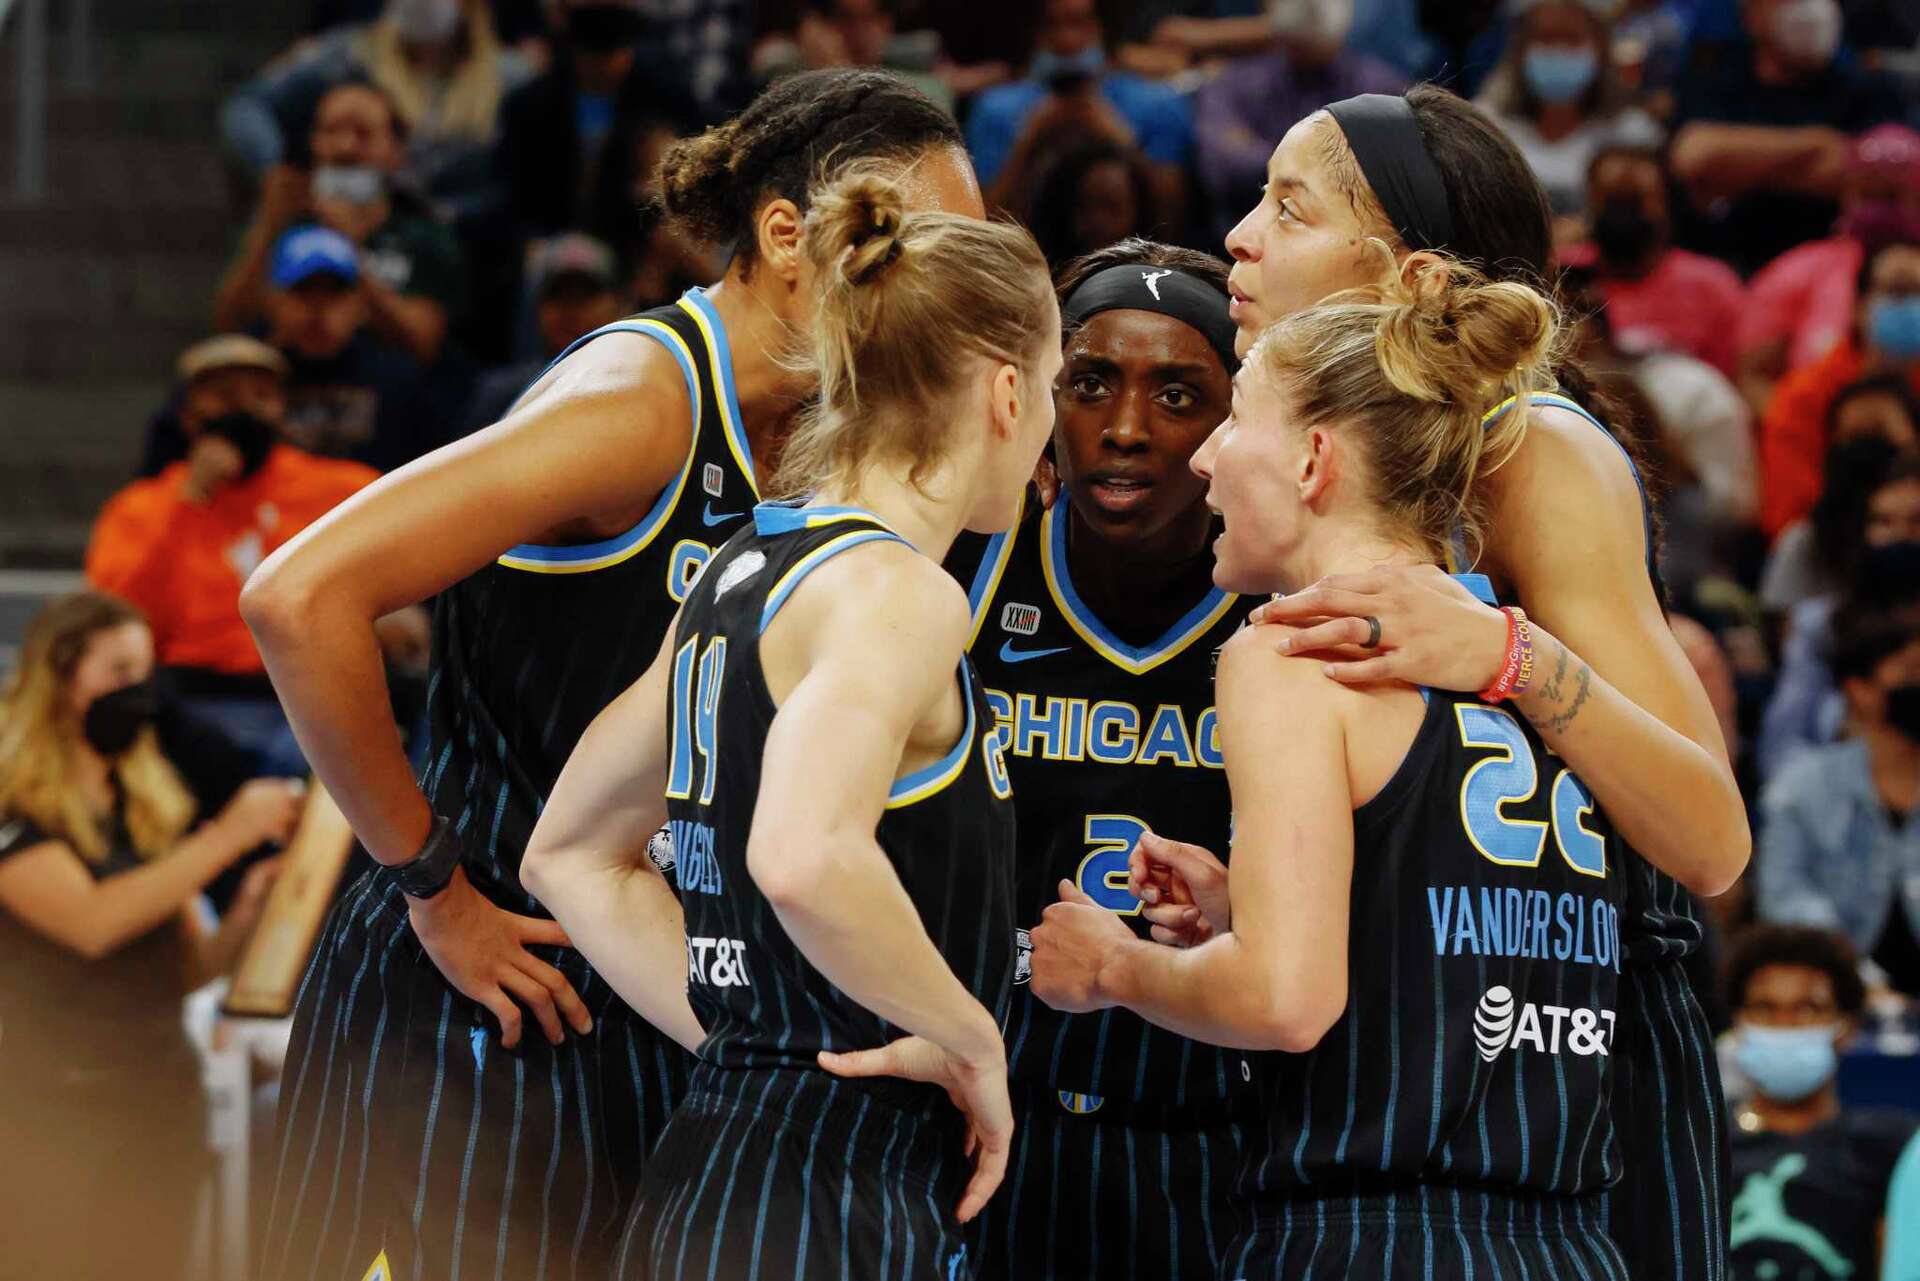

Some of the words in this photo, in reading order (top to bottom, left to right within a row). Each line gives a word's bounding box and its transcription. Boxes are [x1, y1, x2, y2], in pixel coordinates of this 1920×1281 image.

[1515, 647, 1533, 688] FIERCE
[665, 632, 727, 806] 14
[1076, 814, 1153, 916] 2
[686, 936, 750, 987] AT&T
